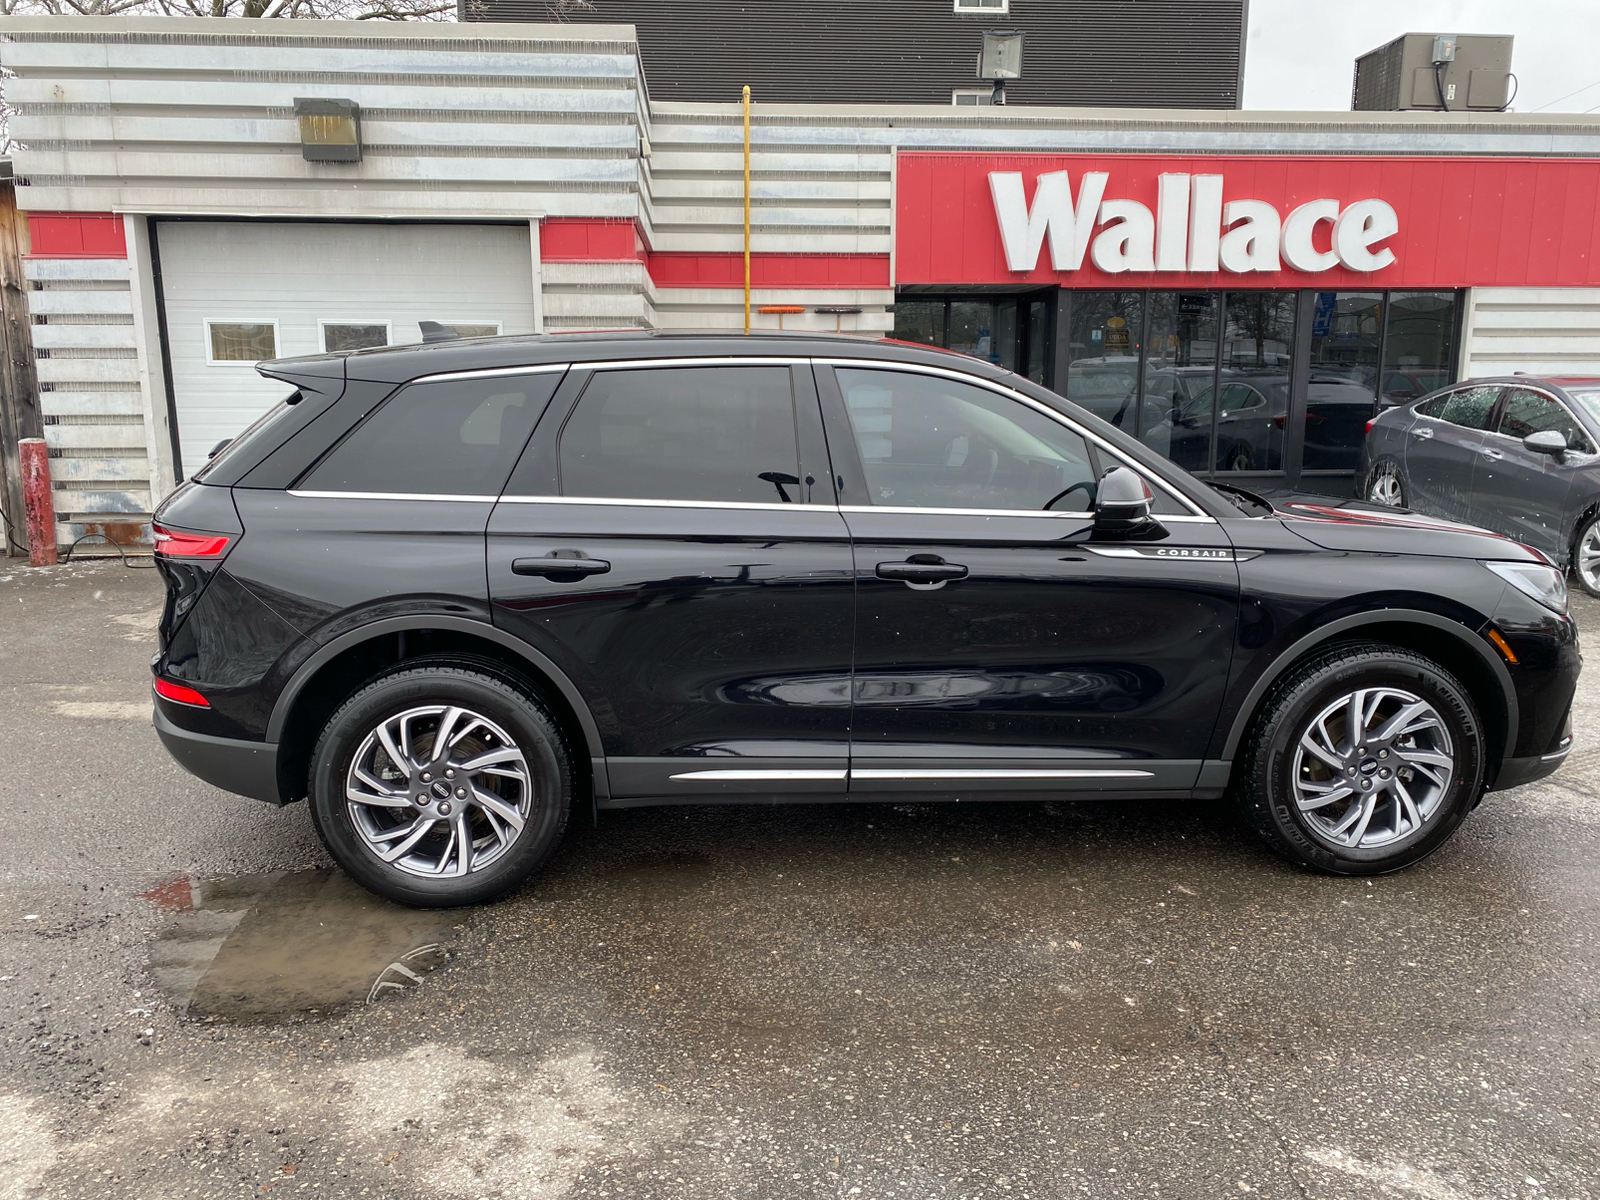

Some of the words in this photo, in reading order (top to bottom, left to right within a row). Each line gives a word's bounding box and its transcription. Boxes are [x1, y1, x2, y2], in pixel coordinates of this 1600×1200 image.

[988, 170, 1399, 275] Wallace
[1157, 549, 1228, 558] CORSAIR
[1438, 686, 1474, 735] MICHELIN
